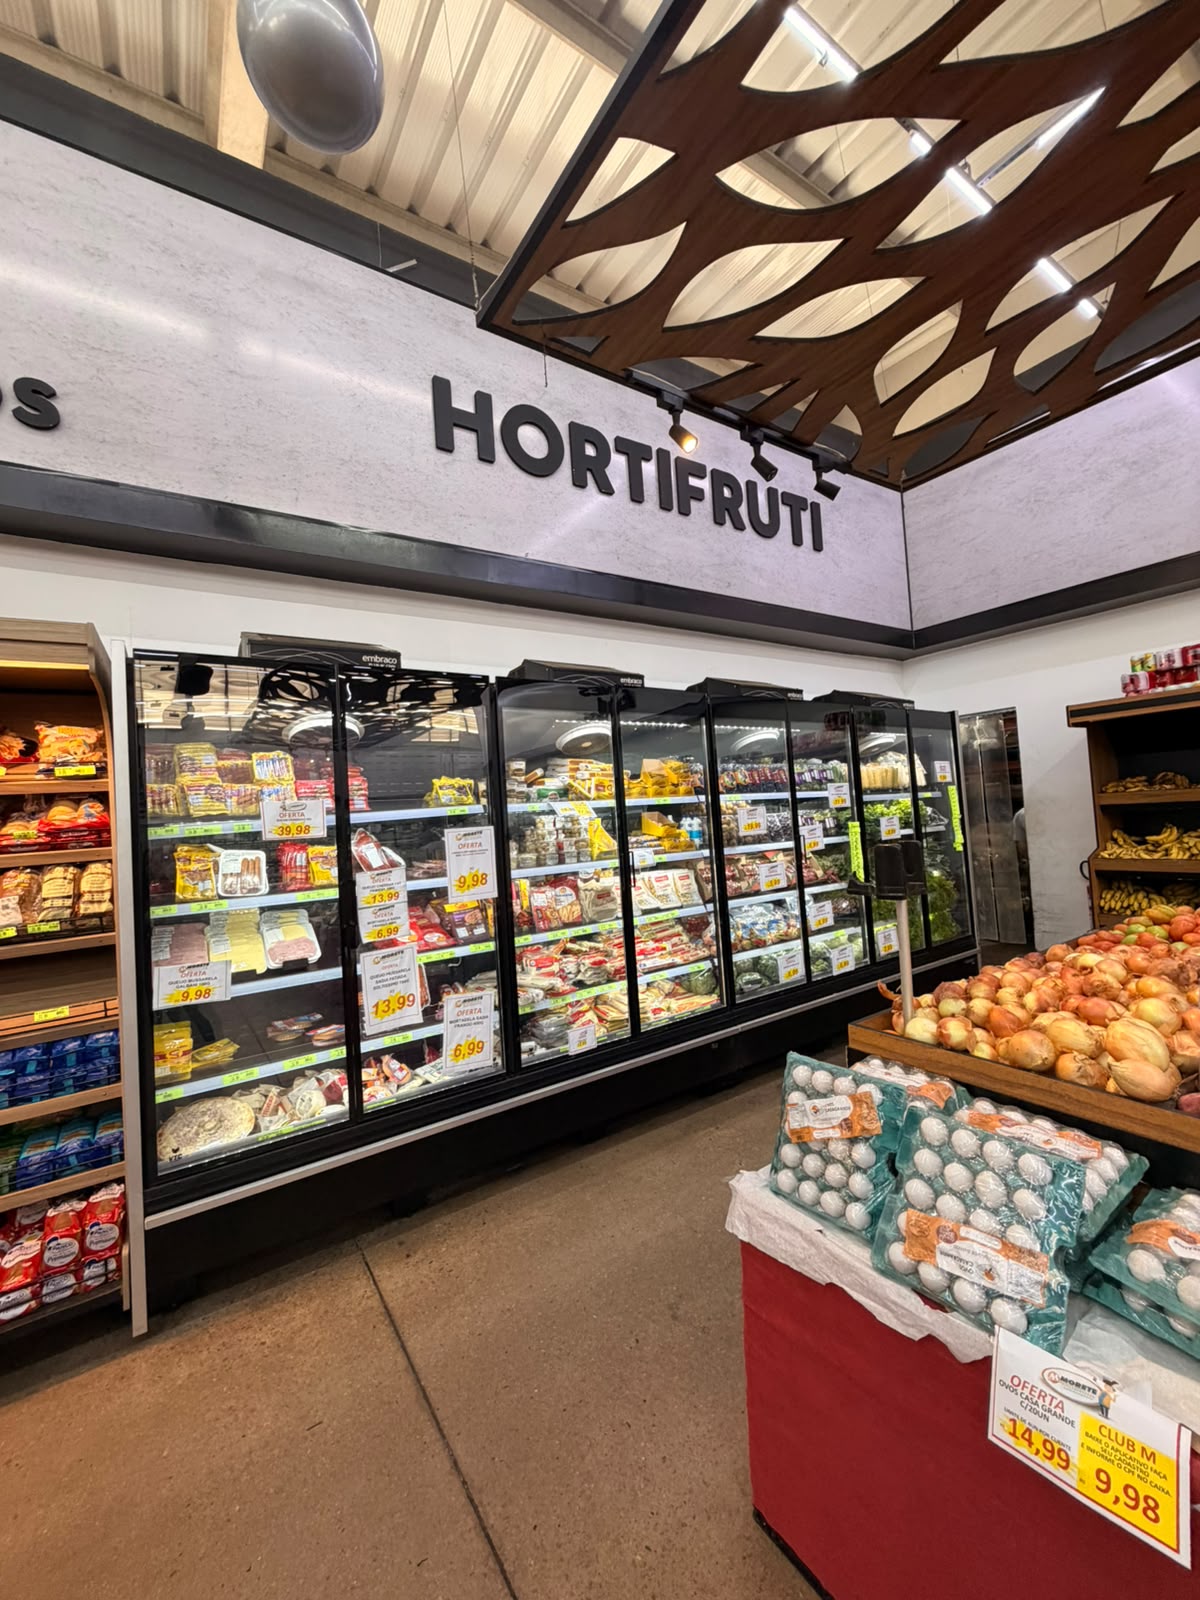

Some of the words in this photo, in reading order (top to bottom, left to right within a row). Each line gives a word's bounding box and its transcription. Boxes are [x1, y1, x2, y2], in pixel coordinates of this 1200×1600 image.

[0, 376, 60, 431] S
[432, 375, 824, 552] HORTIFRUTI
[362, 654, 398, 665] embraco
[279, 811, 305, 819] OFERTA
[277, 824, 311, 837] 39,98
[458, 872, 488, 890] 9,98
[371, 891, 400, 904] 13,99
[376, 926, 399, 939] 6,99
[181, 988, 212, 1003] 9,98
[372, 993, 416, 1016] 13,99
[456, 1008, 482, 1017] OFERTA
[454, 1041, 485, 1060] 6,99
[1010, 1375, 1065, 1413] OFERTA
[1060, 1375, 1098, 1397] MORETE
[998, 1379, 1019, 1396] OVOS
[1020, 1391, 1040, 1409] CASA
[1041, 1404, 1076, 1429] GRANDE
[1020, 1401, 1050, 1422] C/20UN
[1008, 1418, 1071, 1471] 14,99
[1098, 1424, 1136, 1453] CLUB
[1141, 1446, 1157, 1465] M
[1085, 1431, 1102, 1445] BAIXE
[1110, 1445, 1149, 1470] APLICATIVO
[1150, 1464, 1168, 1481] FAÇA
[1086, 1446, 1115, 1466] INFORME
[1123, 1466, 1135, 1476] CPF
[1137, 1473, 1148, 1484] NO
[1100, 1447, 1113, 1457] SEU
[1114, 1454, 1150, 1478] CADASTRO
[1095, 1468, 1161, 1524] 9,98
